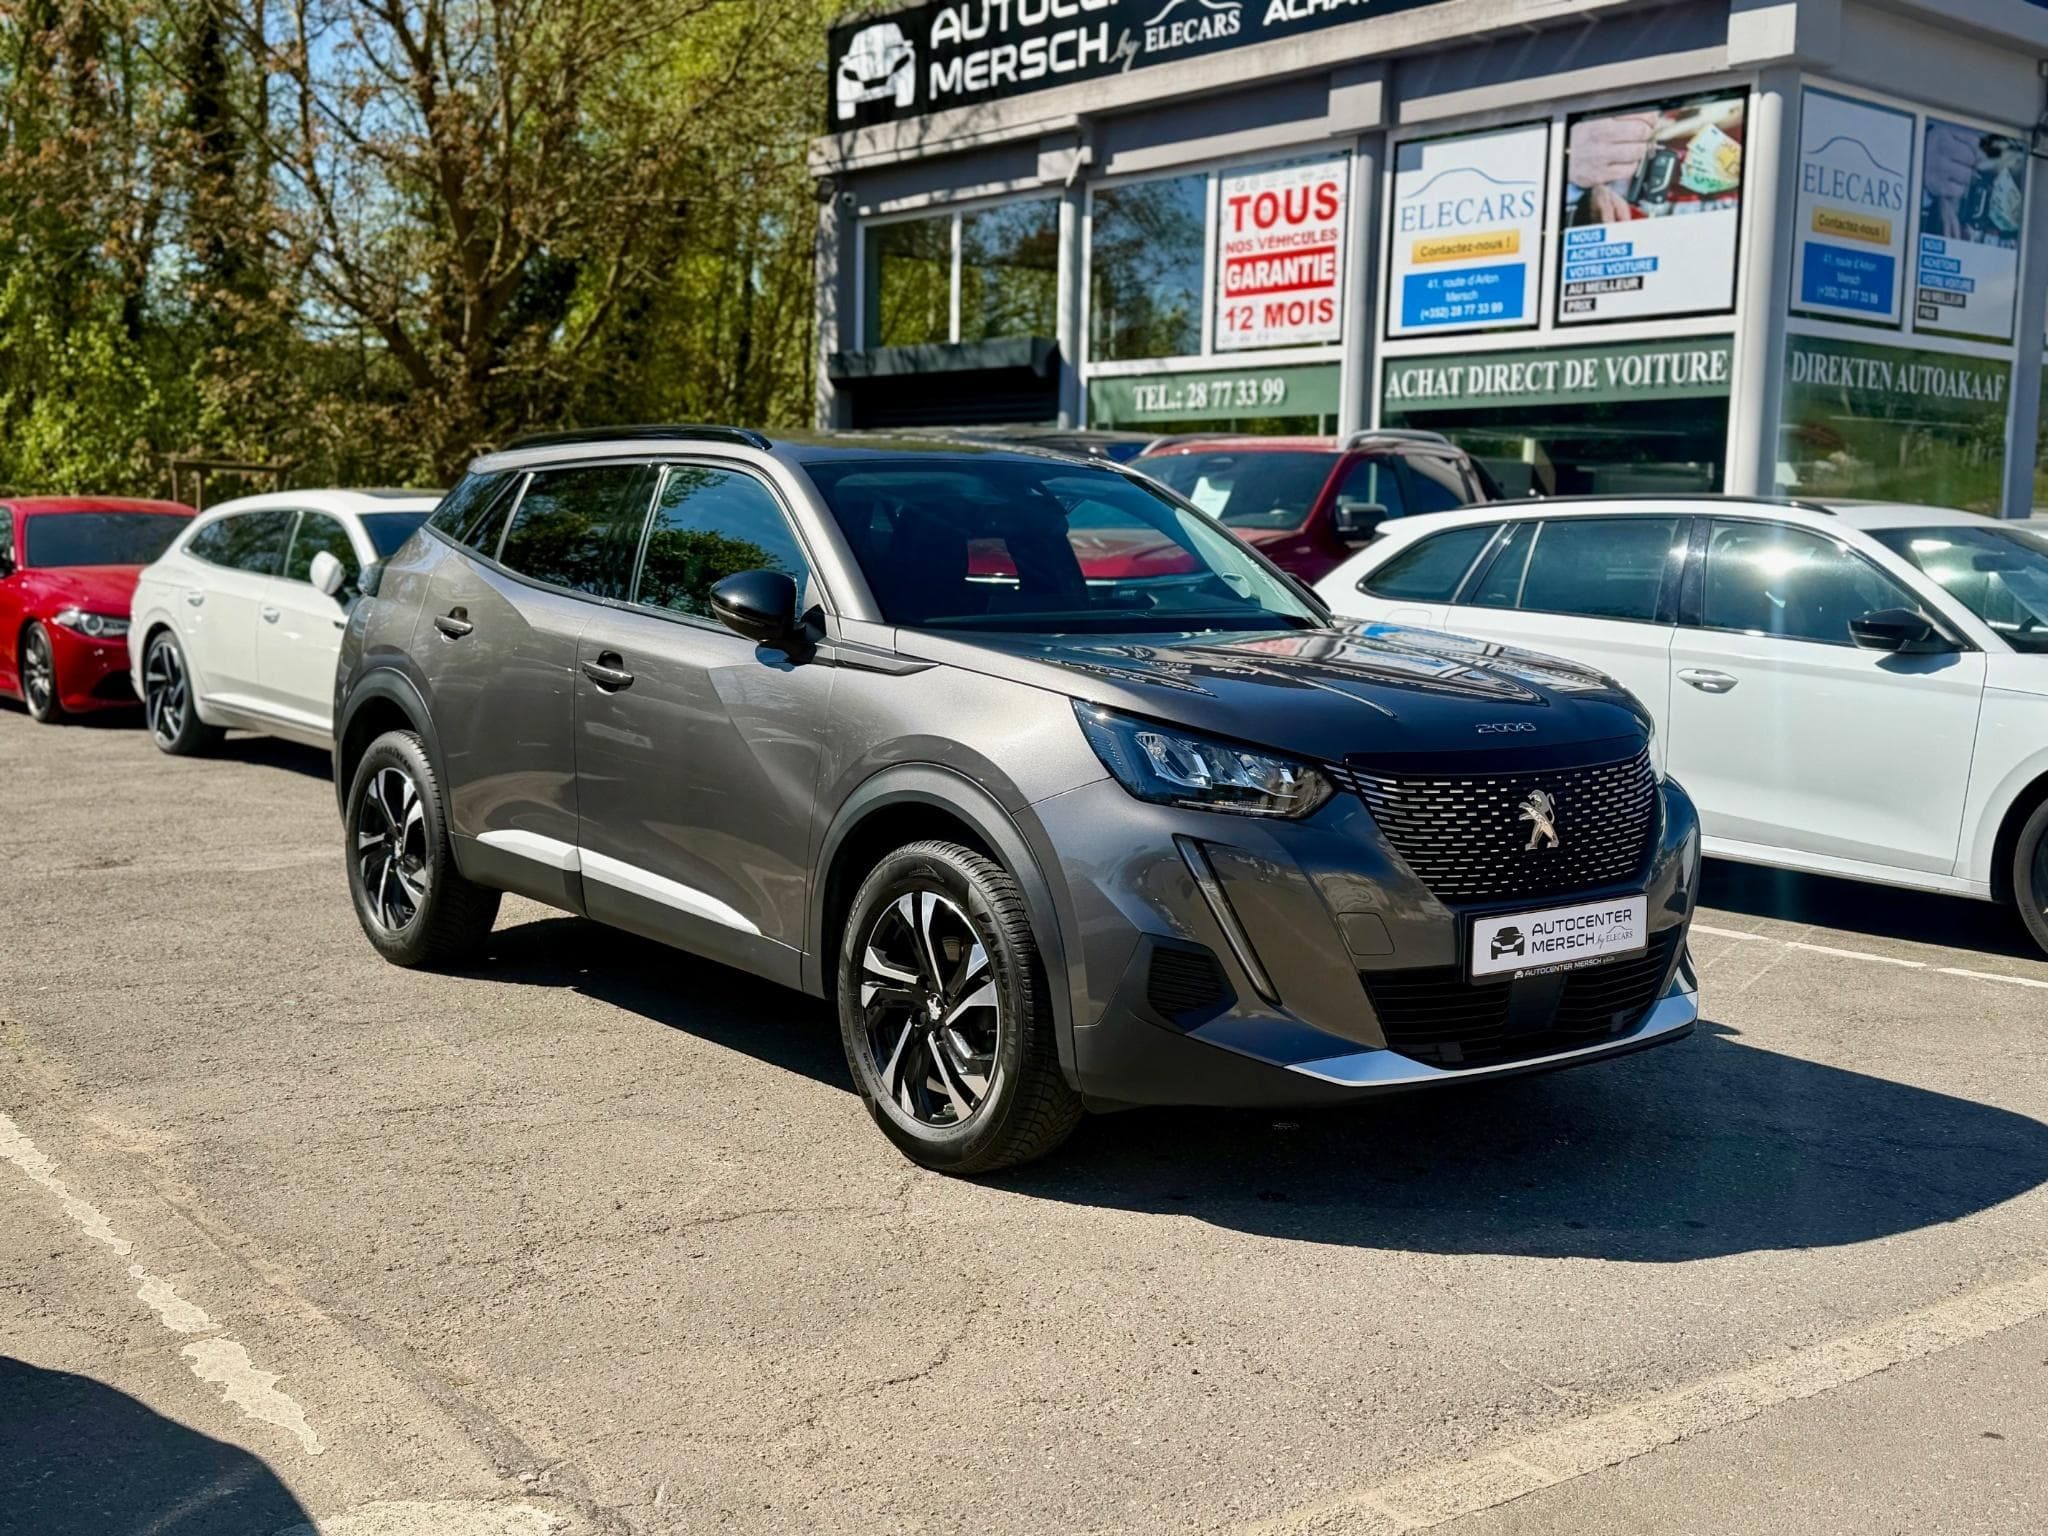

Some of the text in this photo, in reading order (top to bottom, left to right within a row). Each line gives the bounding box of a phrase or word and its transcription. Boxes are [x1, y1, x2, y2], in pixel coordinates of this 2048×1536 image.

[928, 21, 1109, 101] MERSCH
[1144, 9, 1241, 53] ELECARS
[1803, 163, 1903, 212] ELECARS
[1228, 181, 1339, 233] TOUS
[1400, 190, 1535, 232] ELECARS
[1226, 240, 1253, 254] NOS
[1420, 240, 1503, 257] Contactez-nous
[1569, 230, 1601, 244] NOUS
[1569, 244, 1628, 260] ACHETONS
[1226, 252, 1336, 291] GARANTIE
[1568, 258, 1652, 278] VOTRE VOITURE
[1567, 277, 1640, 294] AU MEILLEUR
[1225, 298, 1334, 332] 12 MOIS
[1567, 299, 1592, 312] PRIX
[1384, 350, 1728, 398] ACHAT DIRECT DE VOITURE
[1791, 350, 2006, 402] DIREKTEN AUTOAKAAF
[1186, 381, 1208, 409] 28
[1210, 380, 1233, 407] 77
[1236, 378, 1258, 406] 33
[1261, 376, 1286, 405] 99
[1531, 909, 1632, 937] AUTOCENTER
[1531, 932, 1595, 954] MERSCH
[1525, 962, 1573, 977] AUTOCENTER
[1574, 957, 1602, 969] MERSCH
